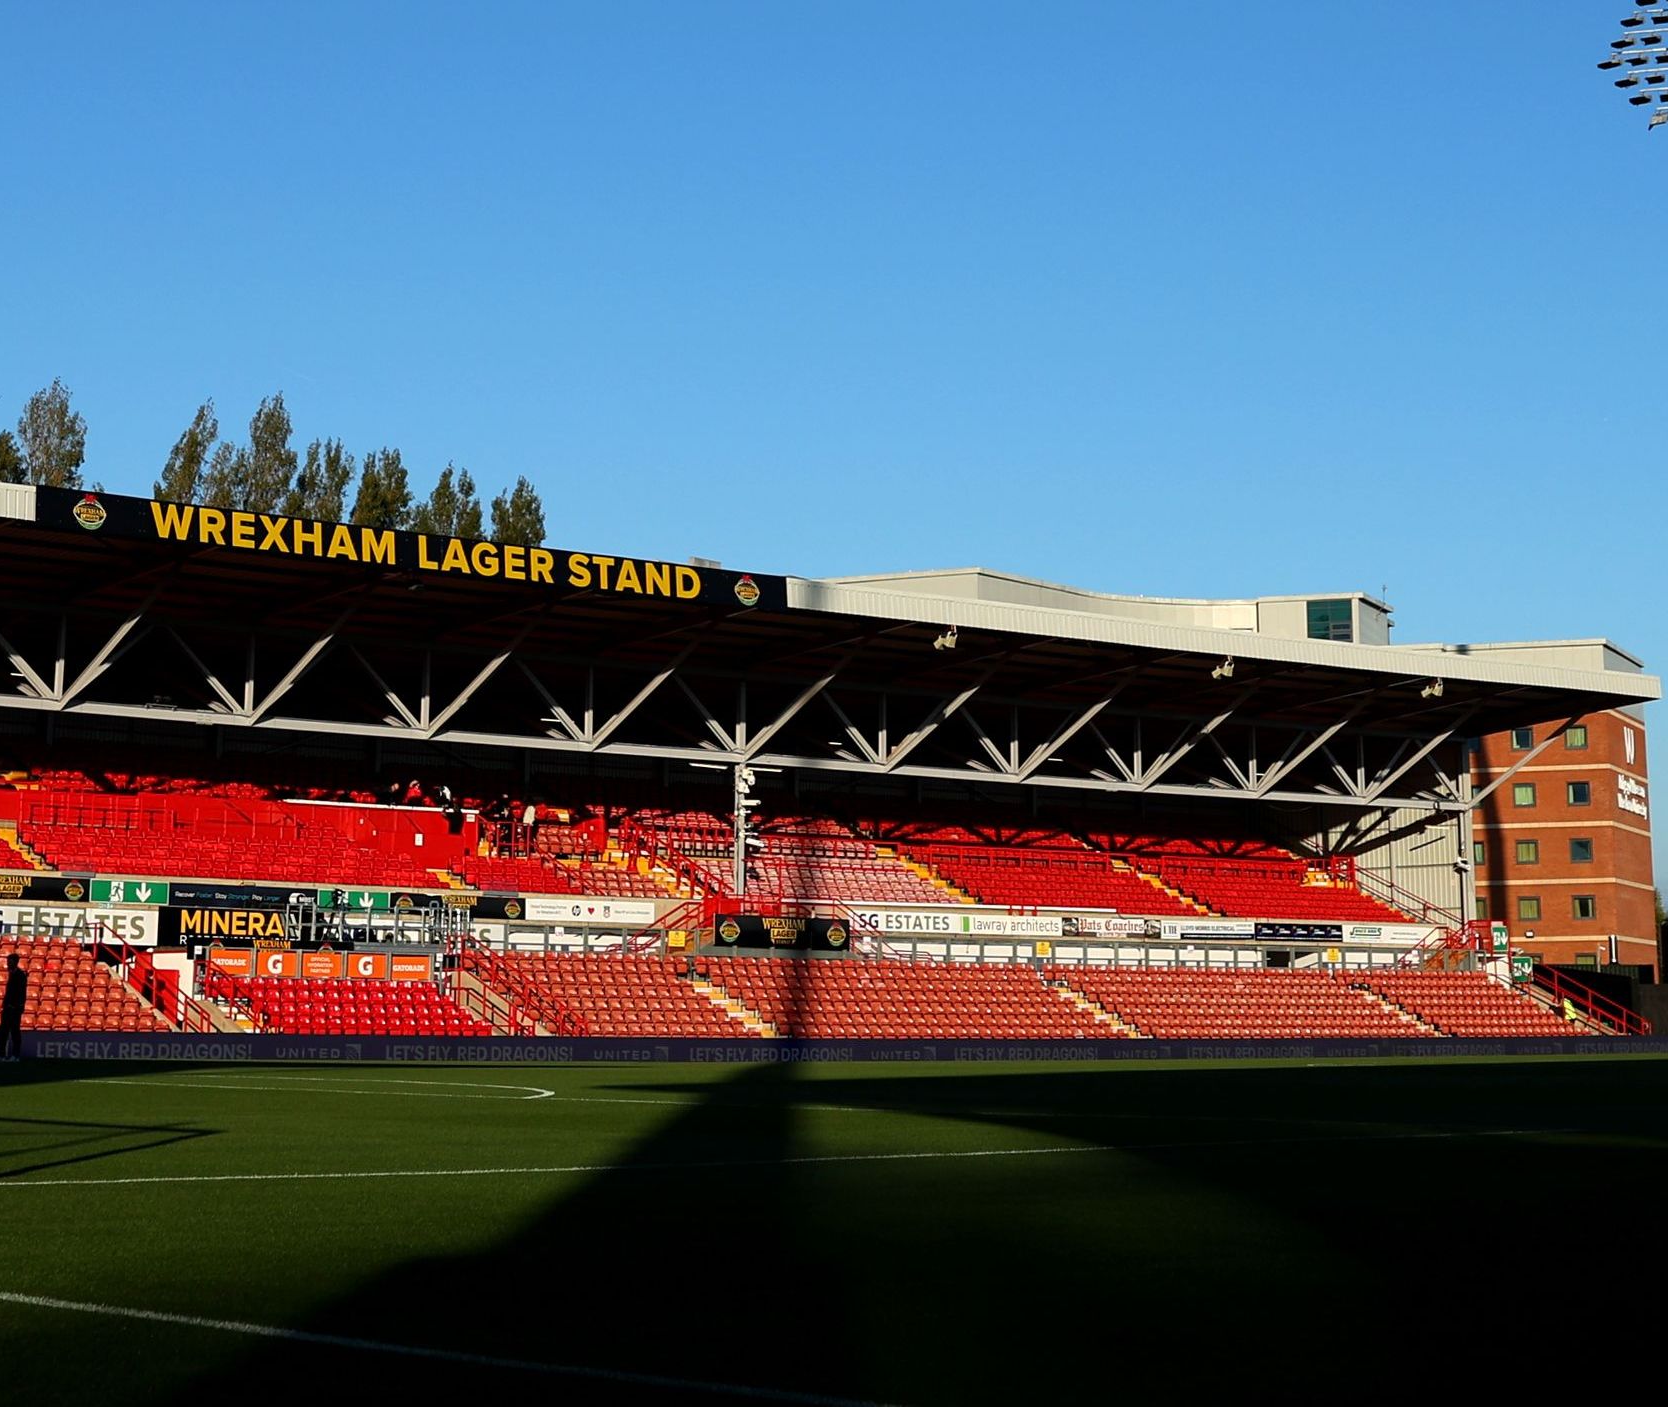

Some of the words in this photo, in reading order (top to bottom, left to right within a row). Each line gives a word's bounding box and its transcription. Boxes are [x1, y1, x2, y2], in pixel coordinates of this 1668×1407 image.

[150, 501, 396, 566] WREXHAM
[418, 533, 554, 585] LAGER
[568, 554, 702, 600] STAND
[17, 910, 145, 941] ESTATES
[180, 908, 285, 936] MINERA
[762, 917, 806, 932] WREXHAM
[858, 913, 879, 929] SG
[885, 914, 950, 930] ESTATES
[973, 917, 1008, 934] lawray
[1010, 918, 1060, 933] architects
[1079, 918, 1102, 931] Pats
[1104, 919, 1144, 932] Coaches
[772, 930, 796, 939] LAGER
[212, 958, 246, 967] GATORADE
[267, 953, 283, 975] G
[357, 955, 374, 976] G
[392, 964, 425, 973] GATORADE
[36, 1040, 81, 1059] LET'S
[119, 1042, 154, 1060] RED
[158, 1043, 253, 1061] DRAGONS!
[276, 1047, 341, 1059] UNITED
[386, 1044, 424, 1061] LET'S
[458, 1046, 487, 1061] RED
[491, 1046, 573, 1062] DRAGONS!
[593, 1049, 651, 1060] UNITED
[689, 1047, 724, 1062] LET'S
[752, 1048, 778, 1062] RED
[781, 1047, 853, 1063] DRAGONS!
[870, 1050, 922, 1061] UNITED
[954, 1047, 984, 1061] LET'S
[1008, 1048, 1032, 1061] RED
[1035, 1047, 1099, 1061] DRAGONS!
[1114, 1050, 1157, 1059] UNITED
[1235, 1047, 1256, 1059] RED
[1258, 1046, 1314, 1059] DRAGONS!
[1328, 1048, 1366, 1057] UNITED
